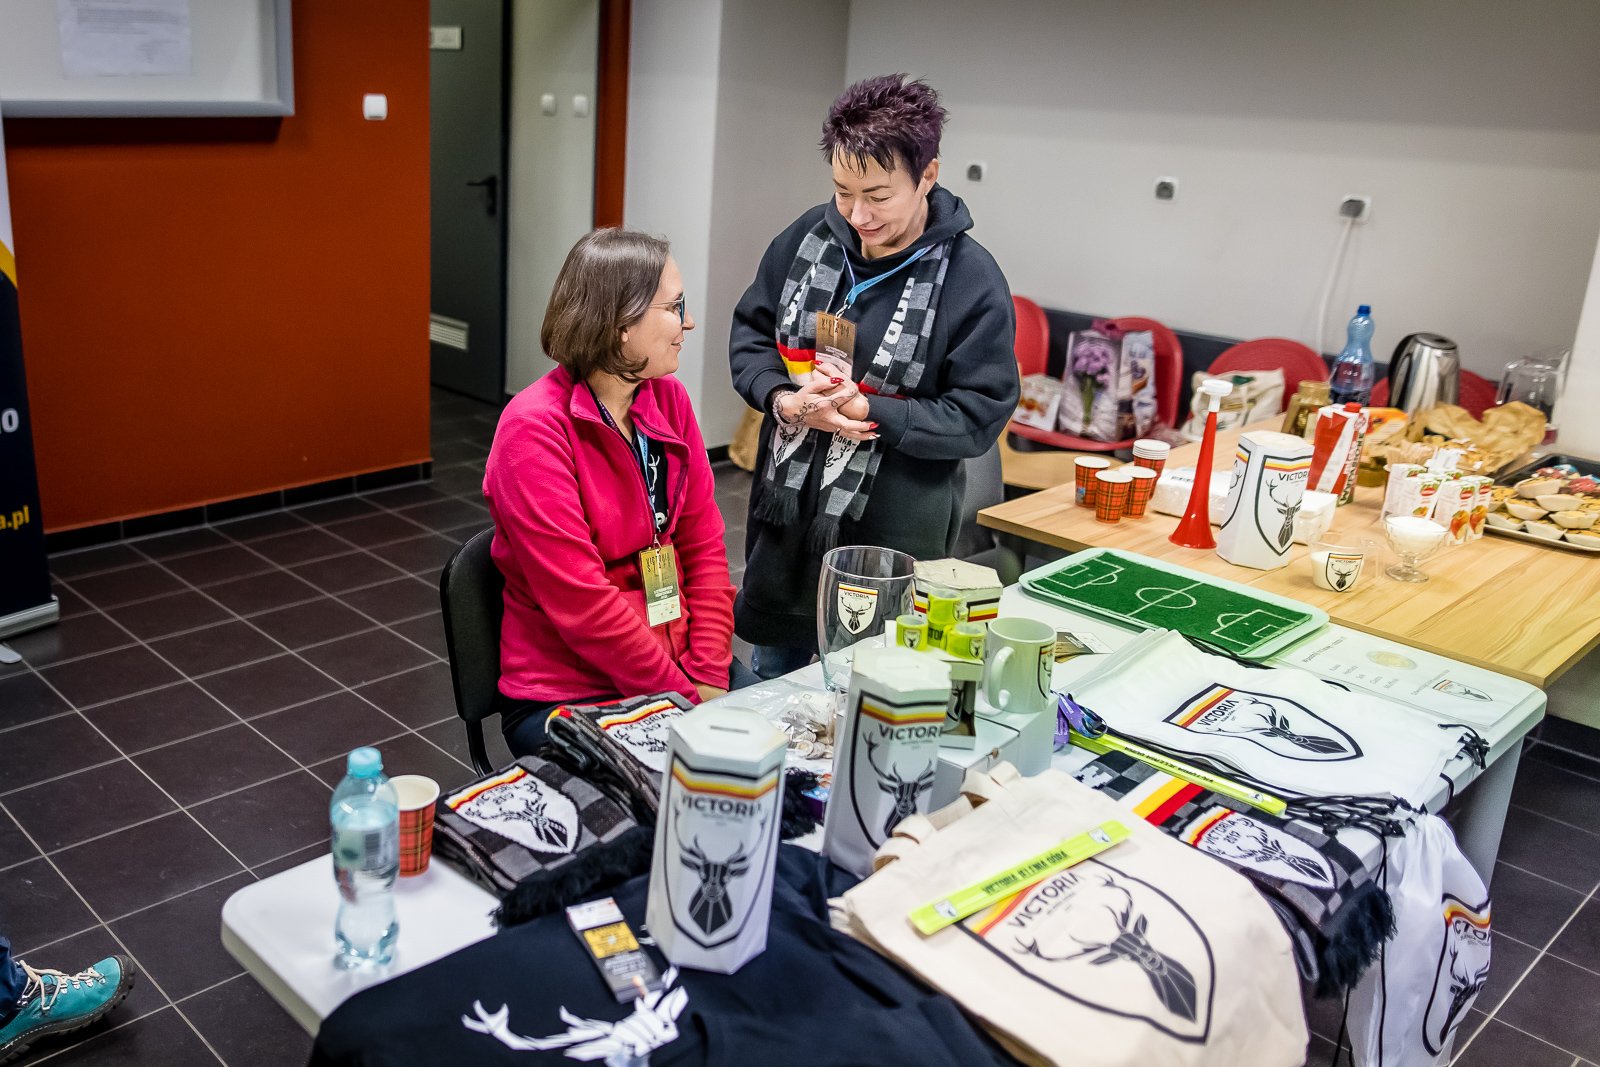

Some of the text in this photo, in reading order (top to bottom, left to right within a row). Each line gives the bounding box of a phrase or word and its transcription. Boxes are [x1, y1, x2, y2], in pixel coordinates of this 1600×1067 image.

[1278, 470, 1310, 482] VICTOR
[843, 591, 870, 600] VICTORIA
[1197, 699, 1240, 727] VICTORIA
[1007, 872, 1085, 928] VICTORIA
